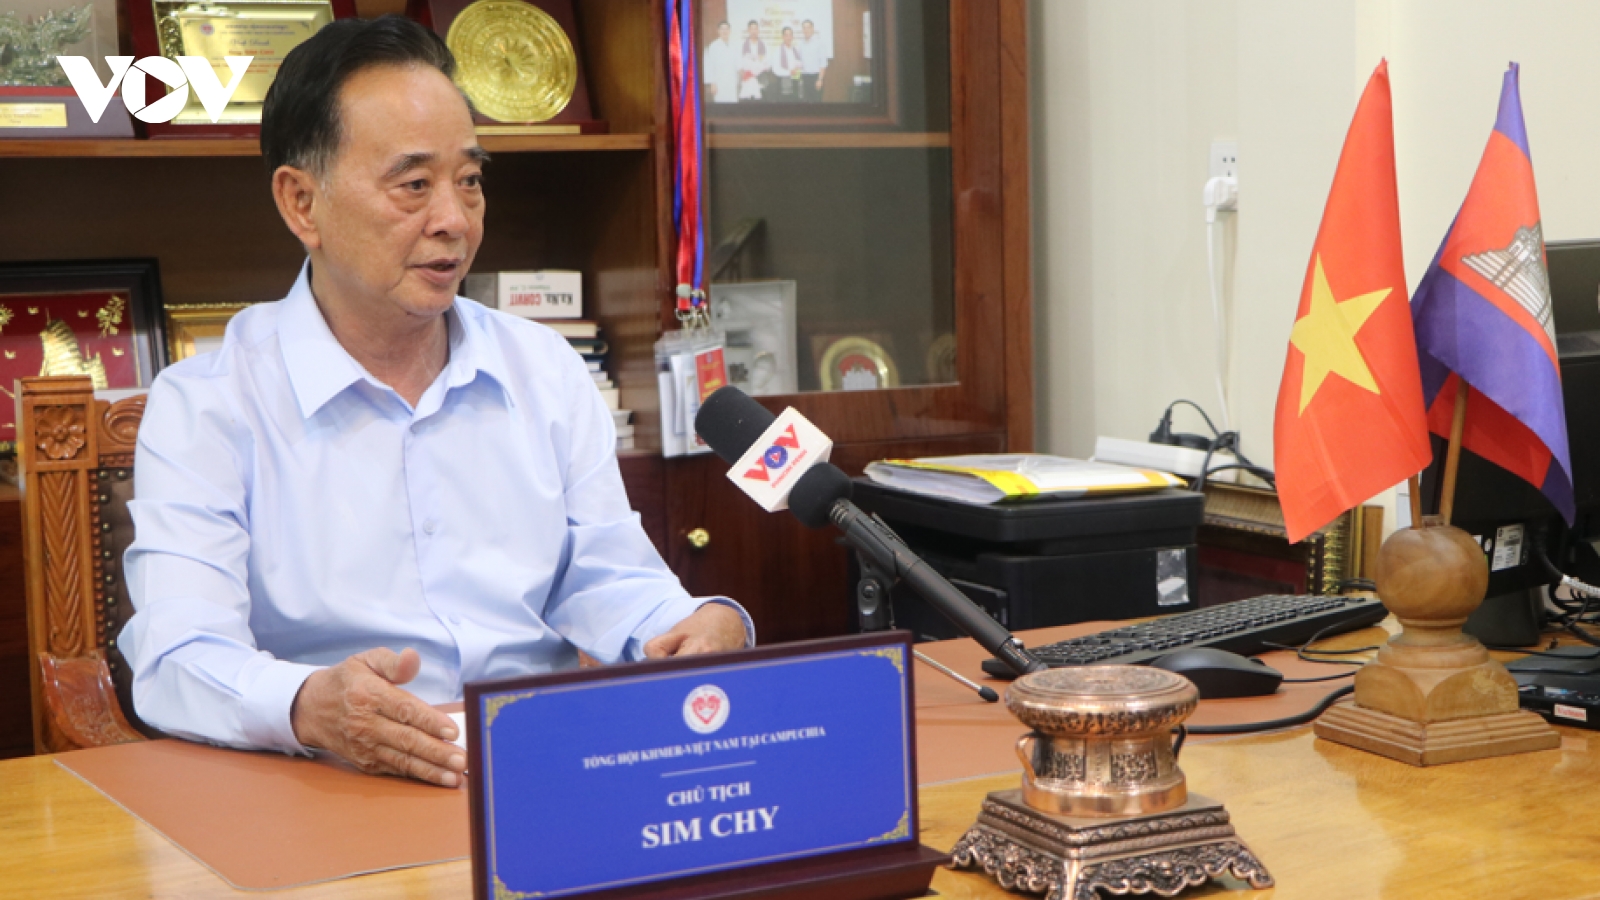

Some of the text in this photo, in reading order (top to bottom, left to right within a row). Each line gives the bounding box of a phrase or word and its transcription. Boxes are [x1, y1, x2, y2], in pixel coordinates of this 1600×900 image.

[743, 423, 800, 481] VOV
[617, 750, 640, 766] HỘI
[714, 738, 740, 750] NAM
[740, 733, 760, 749] TẠI
[761, 726, 827, 745] CAMPUCHIA
[667, 781, 751, 806] CHỦ TỊCH
[641, 805, 780, 848] SIM CHY
